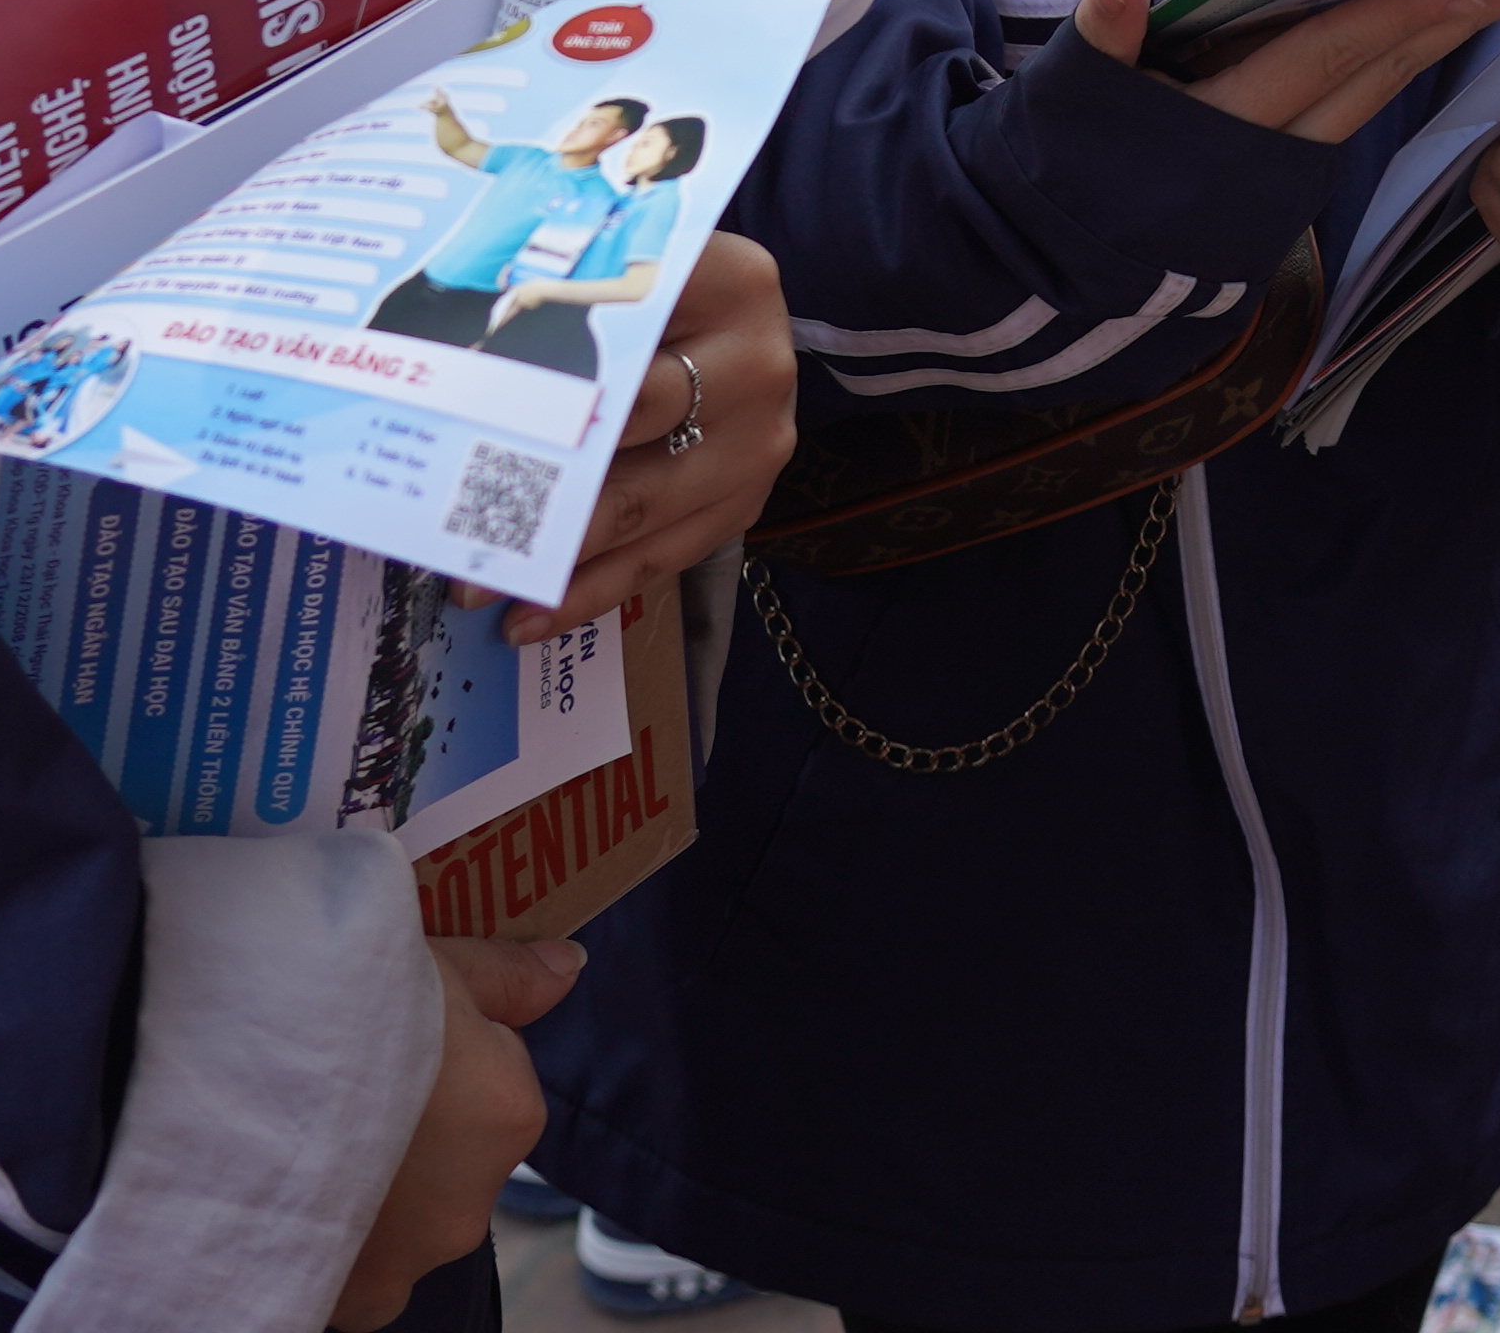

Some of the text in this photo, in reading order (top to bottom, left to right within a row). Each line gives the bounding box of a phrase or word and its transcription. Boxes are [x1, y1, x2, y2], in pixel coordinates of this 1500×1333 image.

[167, 14, 219, 120] HÔNG
[103, 52, 153, 130] ÍNH
[161, 319, 220, 352] ĐÀO
[222, 327, 271, 360] TẠO
[274, 332, 324, 363] VĂN
[231, 553, 255, 591] TẠO
[303, 549, 328, 589] TẠO
[72, 514, 120, 705] ĐÀO TẠO NGẮN HẠN
[145, 507, 195, 718] ĐÀO TẠO SAU ĐẠI HỌC
[225, 596, 252, 634] VĂN
[298, 591, 322, 633] ĐẠI
[219, 639, 246, 691] BẰNG
[290, 634, 315, 672] HỌC
[214, 696, 231, 709] 2
[286, 676, 309, 705] HỆ
[555, 654, 575, 714] HỌC
[205, 712, 229, 756] LIÊN
[277, 708, 306, 766] CHÍNH
[194, 760, 222, 823] THÔNG
[272, 771, 293, 814] QUY
